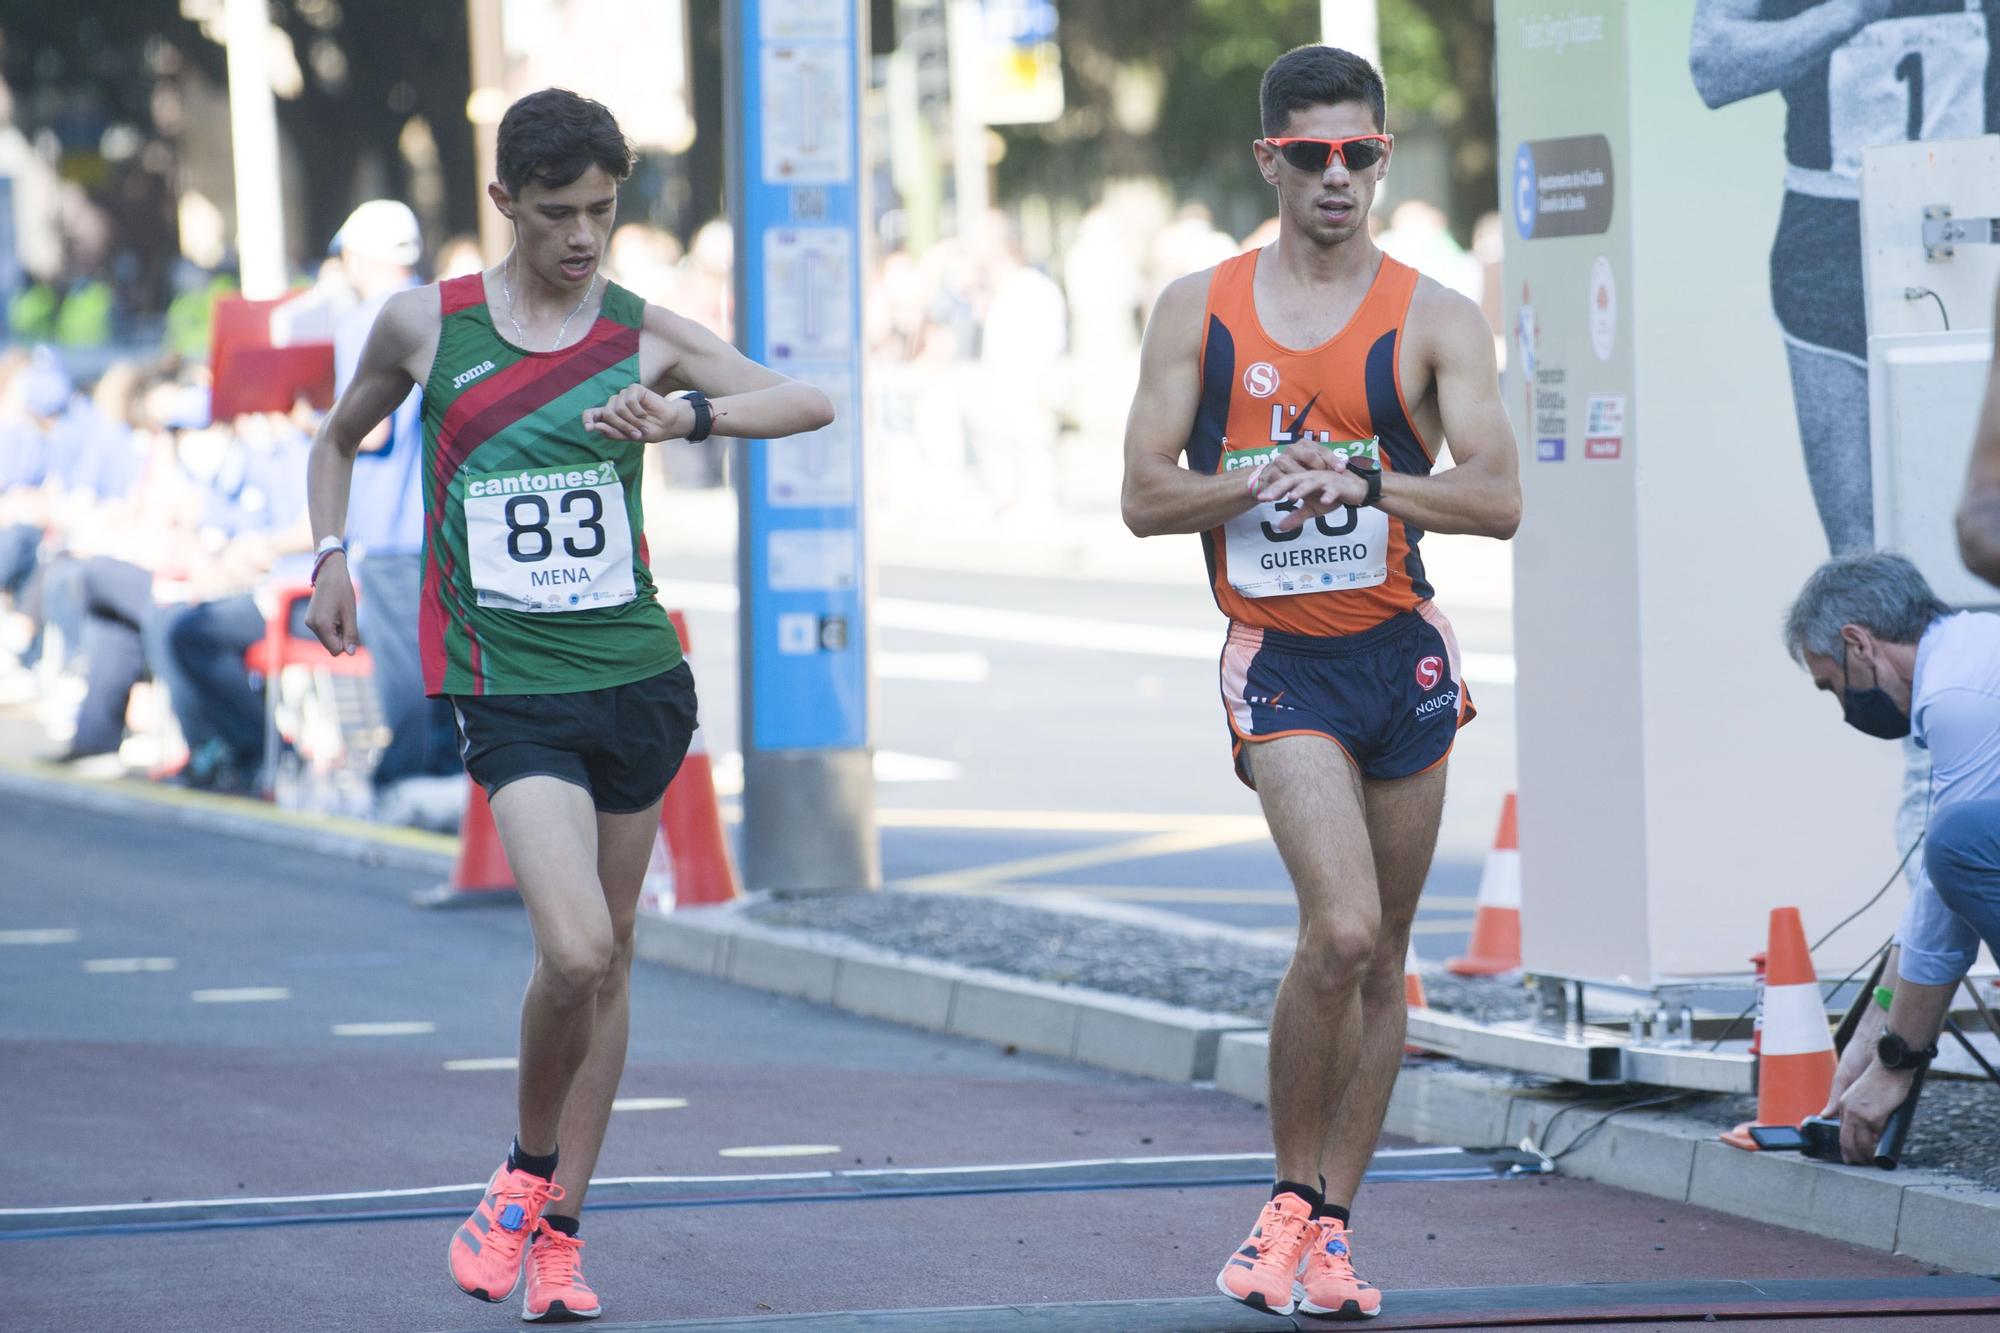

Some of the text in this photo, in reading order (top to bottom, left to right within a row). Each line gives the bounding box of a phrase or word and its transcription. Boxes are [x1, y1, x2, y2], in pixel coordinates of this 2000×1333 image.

[1895, 51, 1923, 141] 1
[453, 361, 495, 389] Joma
[505, 489, 605, 563] 83
[1260, 543, 1368, 570] GUERRERO
[531, 567, 591, 587] MENA
